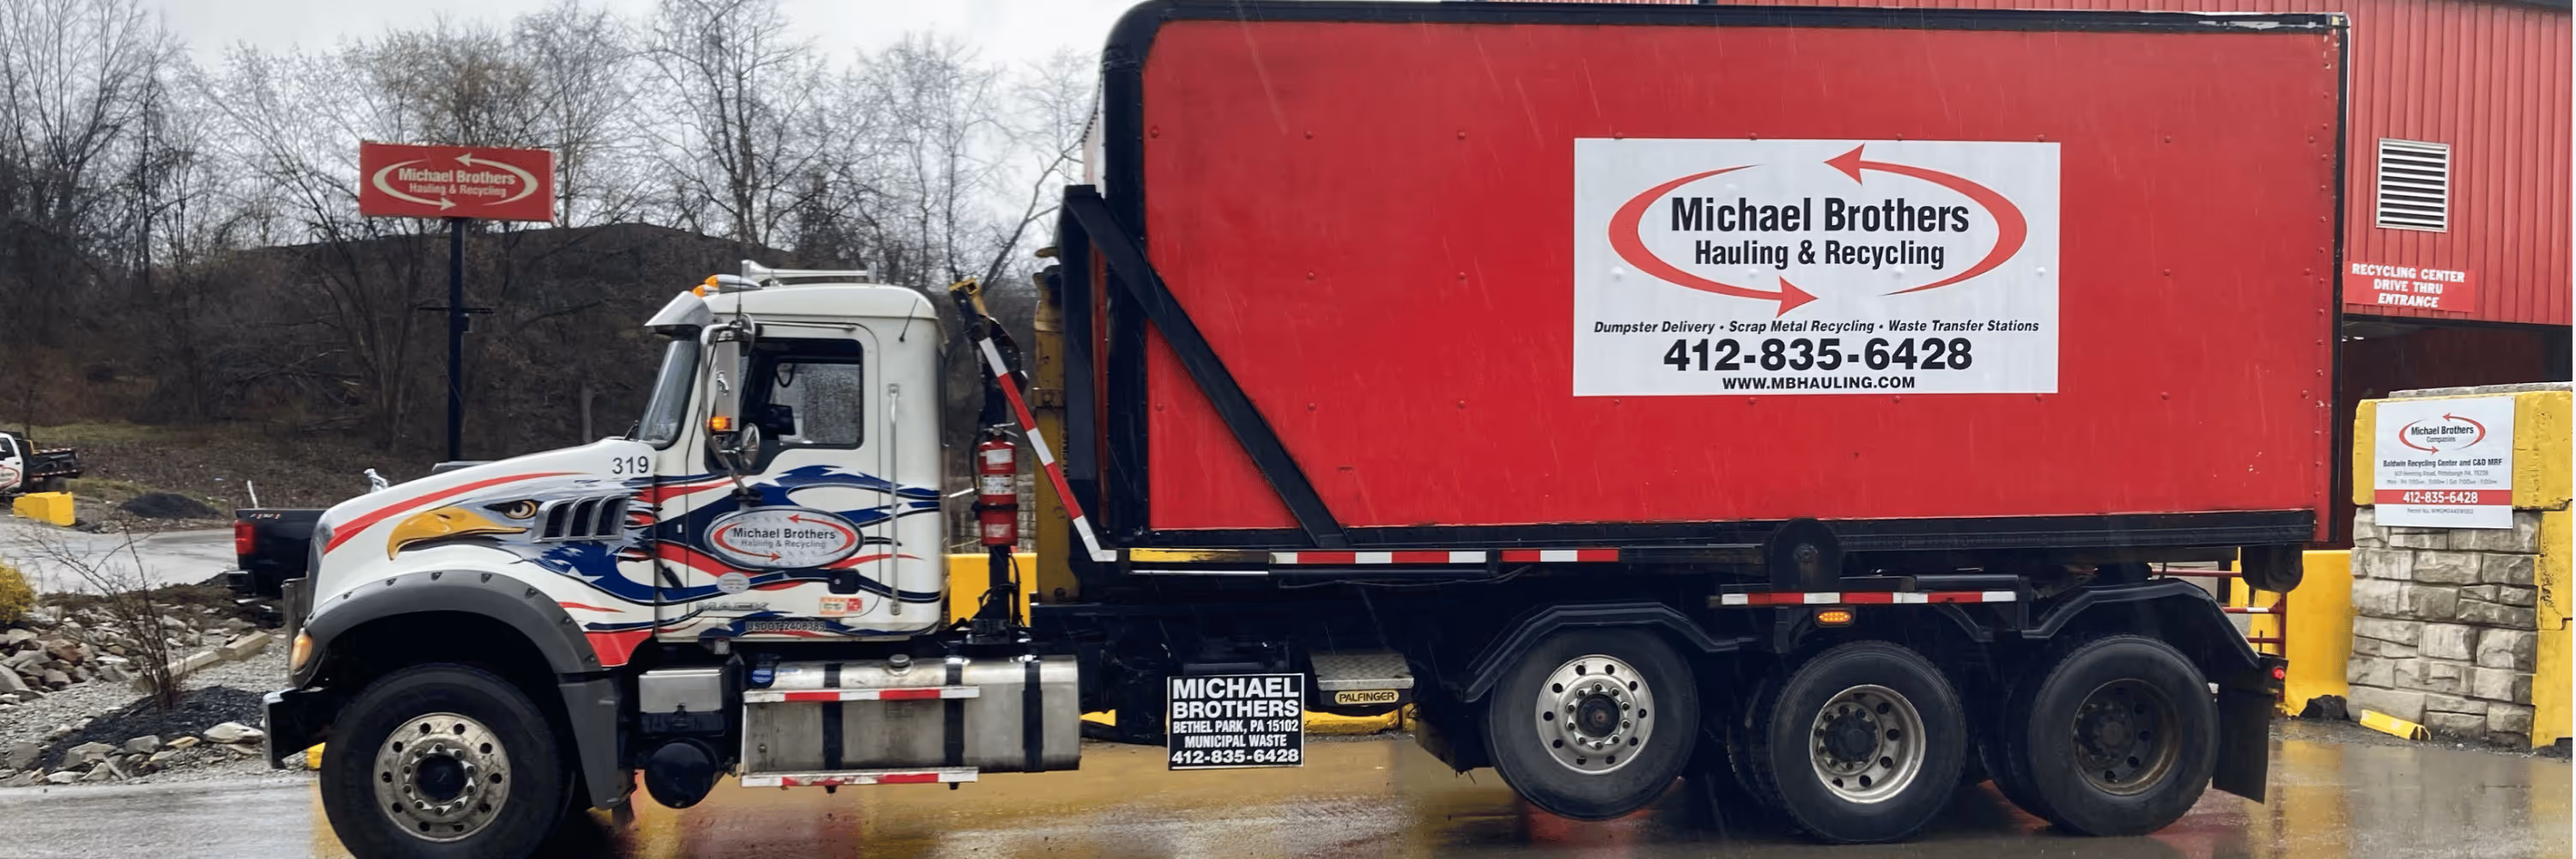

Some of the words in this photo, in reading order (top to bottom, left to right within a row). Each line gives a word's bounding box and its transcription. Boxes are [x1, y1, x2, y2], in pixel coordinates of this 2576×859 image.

[398, 168, 453, 183] Michael
[457, 170, 515, 186] Brothers
[410, 182, 446, 195] Hauling
[449, 184, 456, 193] &
[459, 186, 507, 198] Recycling
[1671, 197, 1811, 232] Michael
[1825, 197, 1970, 233] Brothers
[1695, 240, 1789, 270] Hauling
[1798, 240, 1816, 265] &
[1826, 240, 1945, 270] Recycling
[2352, 263, 2416, 279] RECYCLING
[2421, 268, 2465, 283] CENTER
[2373, 278, 2409, 292] DRIVE
[2413, 281, 2444, 295] THRU
[2378, 293, 2439, 308] ENTRANCE
[1594, 321, 1658, 335] Dumpster
[1662, 320, 1716, 334] Delivery
[1728, 320, 1766, 334] Scrap
[1771, 320, 1807, 332] Metal
[1810, 320, 1874, 333] Recycling
[1889, 320, 1927, 332] Waste
[1932, 320, 1984, 332] Transfer
[1987, 320, 2039, 332] Stations
[1663, 338, 1972, 371] 412-835-6428
[1722, 376, 1915, 389] WWW.MBHAULING.COM
[2411, 426, 2439, 436] Michael
[2441, 426, 2474, 436] Brothers
[611, 455, 649, 474] 319
[2408, 460, 2436, 468] Recycling
[2403, 490, 2479, 503] 412-835-6428
[733, 527, 780, 539] Michael
[784, 527, 836, 539] Brothers
[785, 539, 826, 549] Recycling
[696, 601, 769, 612] MACK
[1172, 677, 1299, 699] MICHAEL
[1339, 691, 1395, 703] PALFINGER
[1172, 699, 1299, 719] BROTHERS
[1173, 721, 1213, 734] BETHEL
[1215, 720, 1248, 734] PARK,
[1250, 720, 1265, 733] PA
[1267, 719, 1299, 732] 15102
[1184, 734, 1246, 748] MUNICIPAL
[1249, 734, 1287, 747] WASTE
[1171, 749, 1299, 765] 412-835-6428
